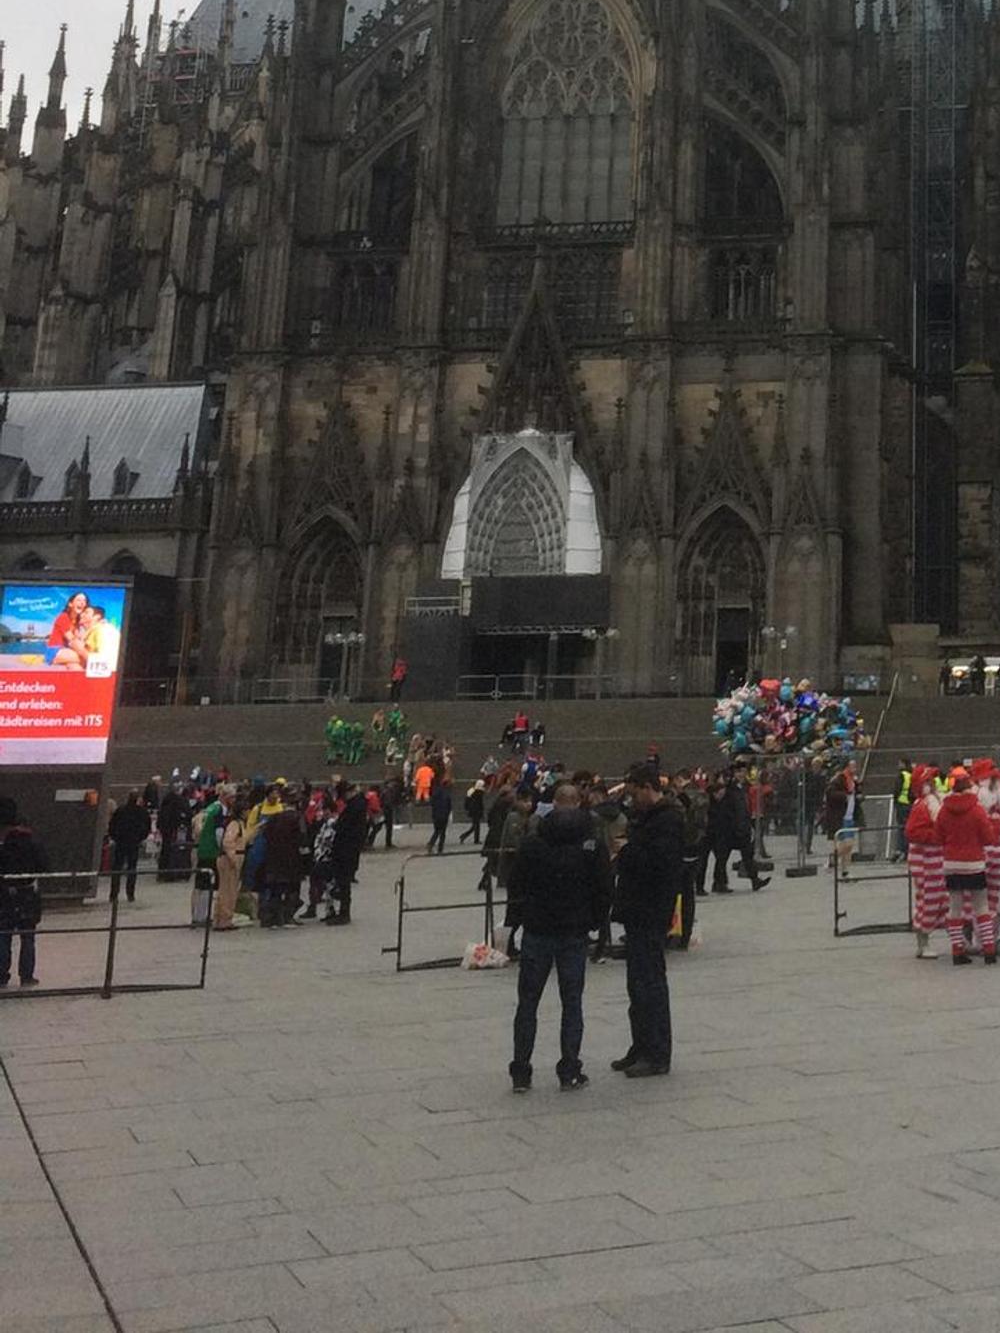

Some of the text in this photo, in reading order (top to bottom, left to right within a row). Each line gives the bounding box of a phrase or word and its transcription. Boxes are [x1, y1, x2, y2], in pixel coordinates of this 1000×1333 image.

[90, 662, 108, 671] ITS
[19, 698, 63, 710] erleben:
[0, 714, 104, 727] tädtereisen mit ITS
